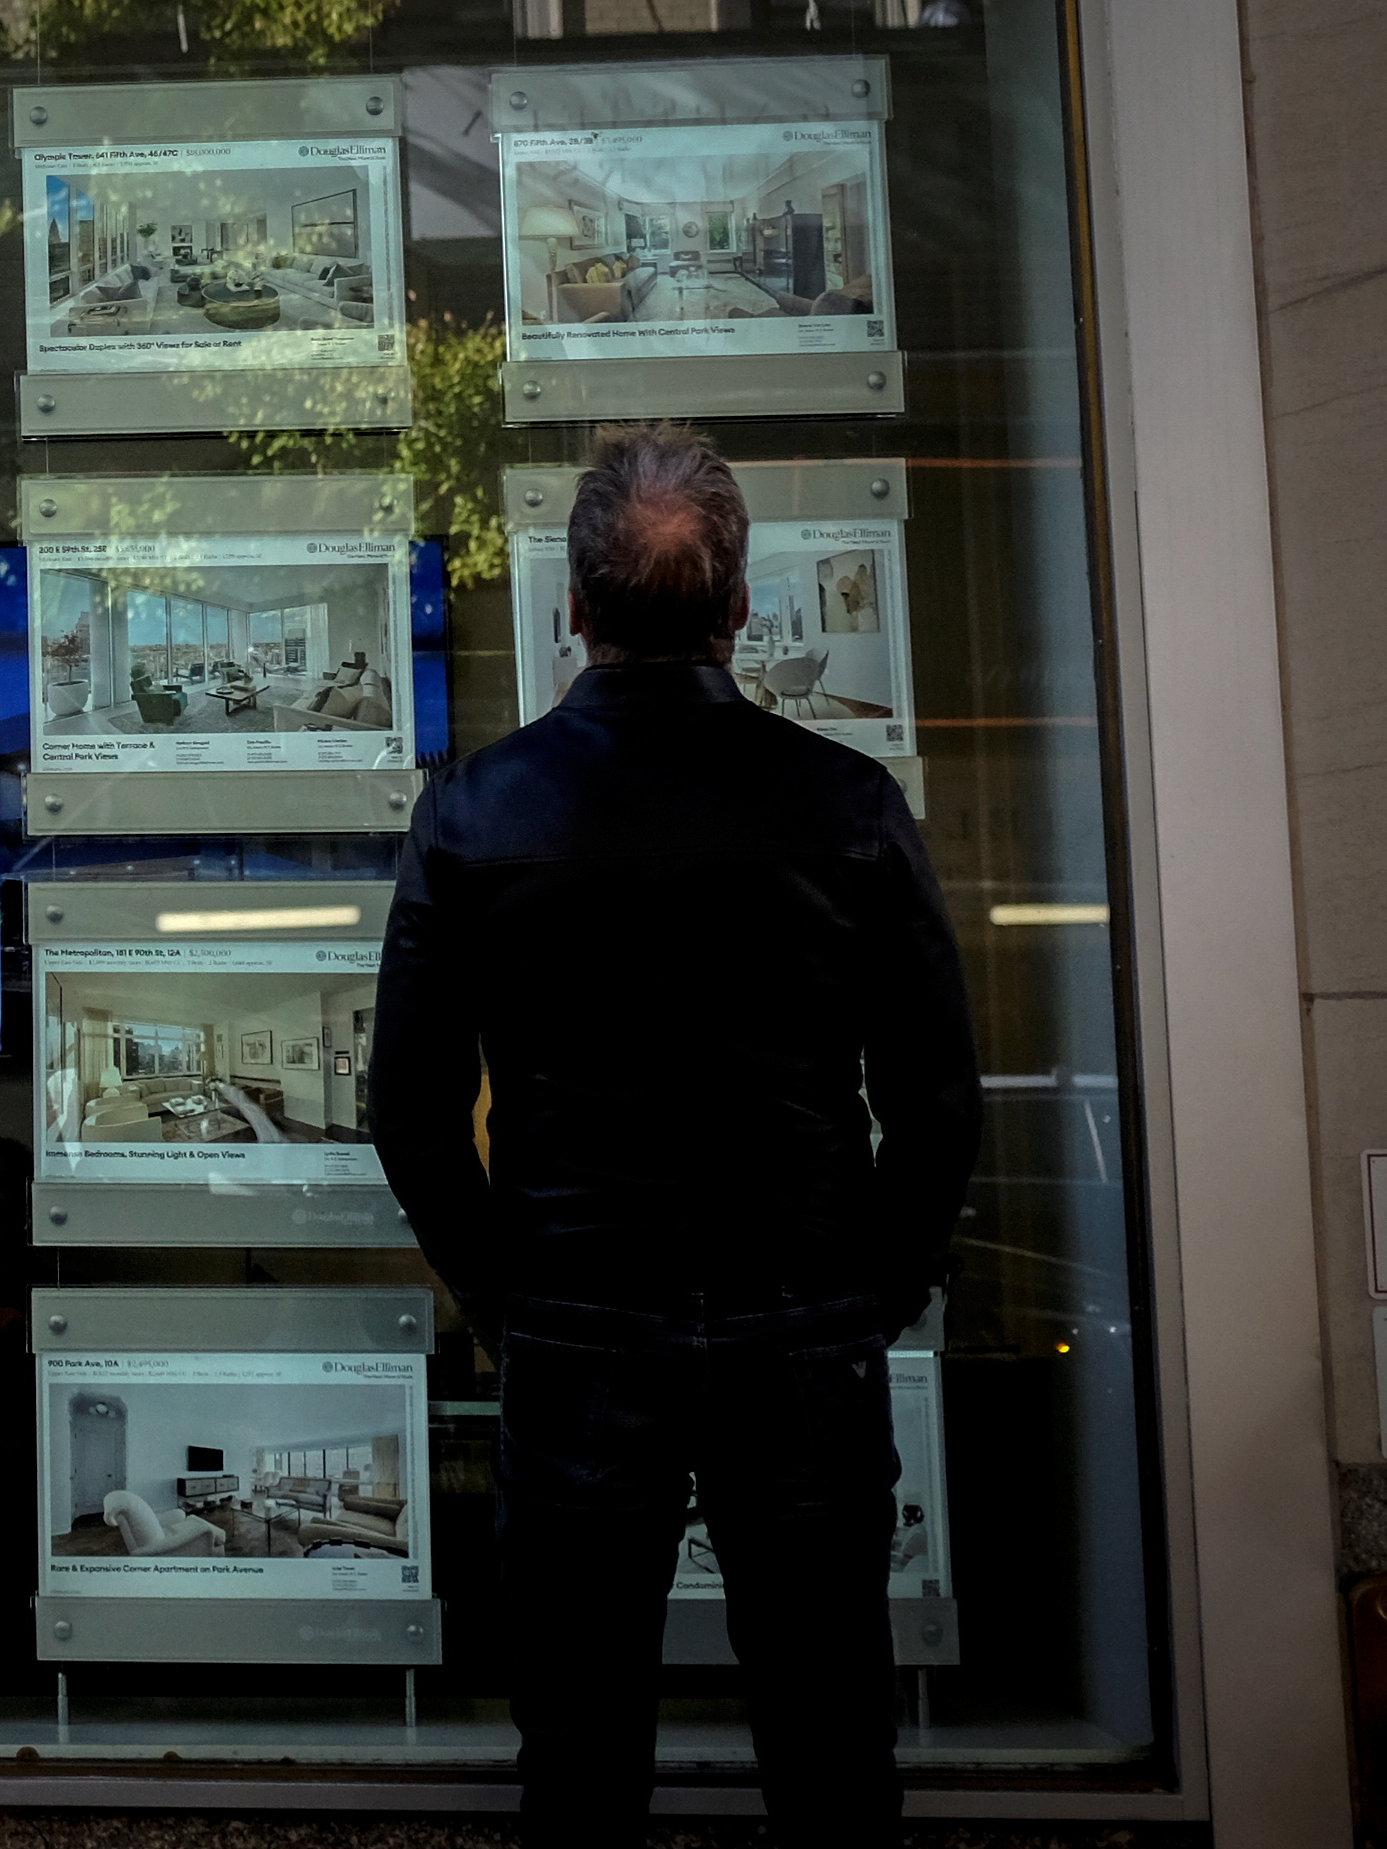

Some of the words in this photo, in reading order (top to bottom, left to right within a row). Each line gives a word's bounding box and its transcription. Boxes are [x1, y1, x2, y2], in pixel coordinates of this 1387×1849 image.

[34, 153, 65, 163] Olympic
[521, 331, 565, 340] Beautifully
[566, 330, 611, 338] Renovated
[638, 329, 657, 337] With
[658, 327, 690, 336] Central
[691, 327, 709, 335] Park
[710, 326, 736, 334] Views
[39, 345, 87, 353] Spectacular
[156, 341, 180, 349] Views
[194, 340, 212, 348] Sale
[72, 742, 96, 750] Home
[97, 742, 115, 750] with
[116, 742, 148, 750] Terrace
[42, 753, 73, 761] Central
[74, 752, 93, 760] Park
[94, 752, 119, 760] Views
[44, 949, 59, 957] The
[60, 949, 114, 958] Metropolitan,
[134, 949, 154, 957] 90th
[327, 951, 382, 964] DouglasEll
[128, 1150, 165, 1160] Stunning
[166, 1150, 187, 1160] Light
[188, 1150, 196, 1159] &
[196, 1150, 220, 1160] Open
[221, 1150, 246, 1159] Views
[47, 1360, 63, 1368] 900
[64, 1360, 83, 1368] Park
[84, 1360, 102, 1369] Ave,
[50, 1564, 70, 1573] Rare
[71, 1564, 78, 1573] &
[79, 1564, 122, 1574] Expansive
[123, 1565, 151, 1573] Corner
[153, 1565, 199, 1574] Apartment
[212, 1565, 231, 1574] Park
[232, 1565, 264, 1574] Avenue
[676, 1581, 723, 1589] Condomini
